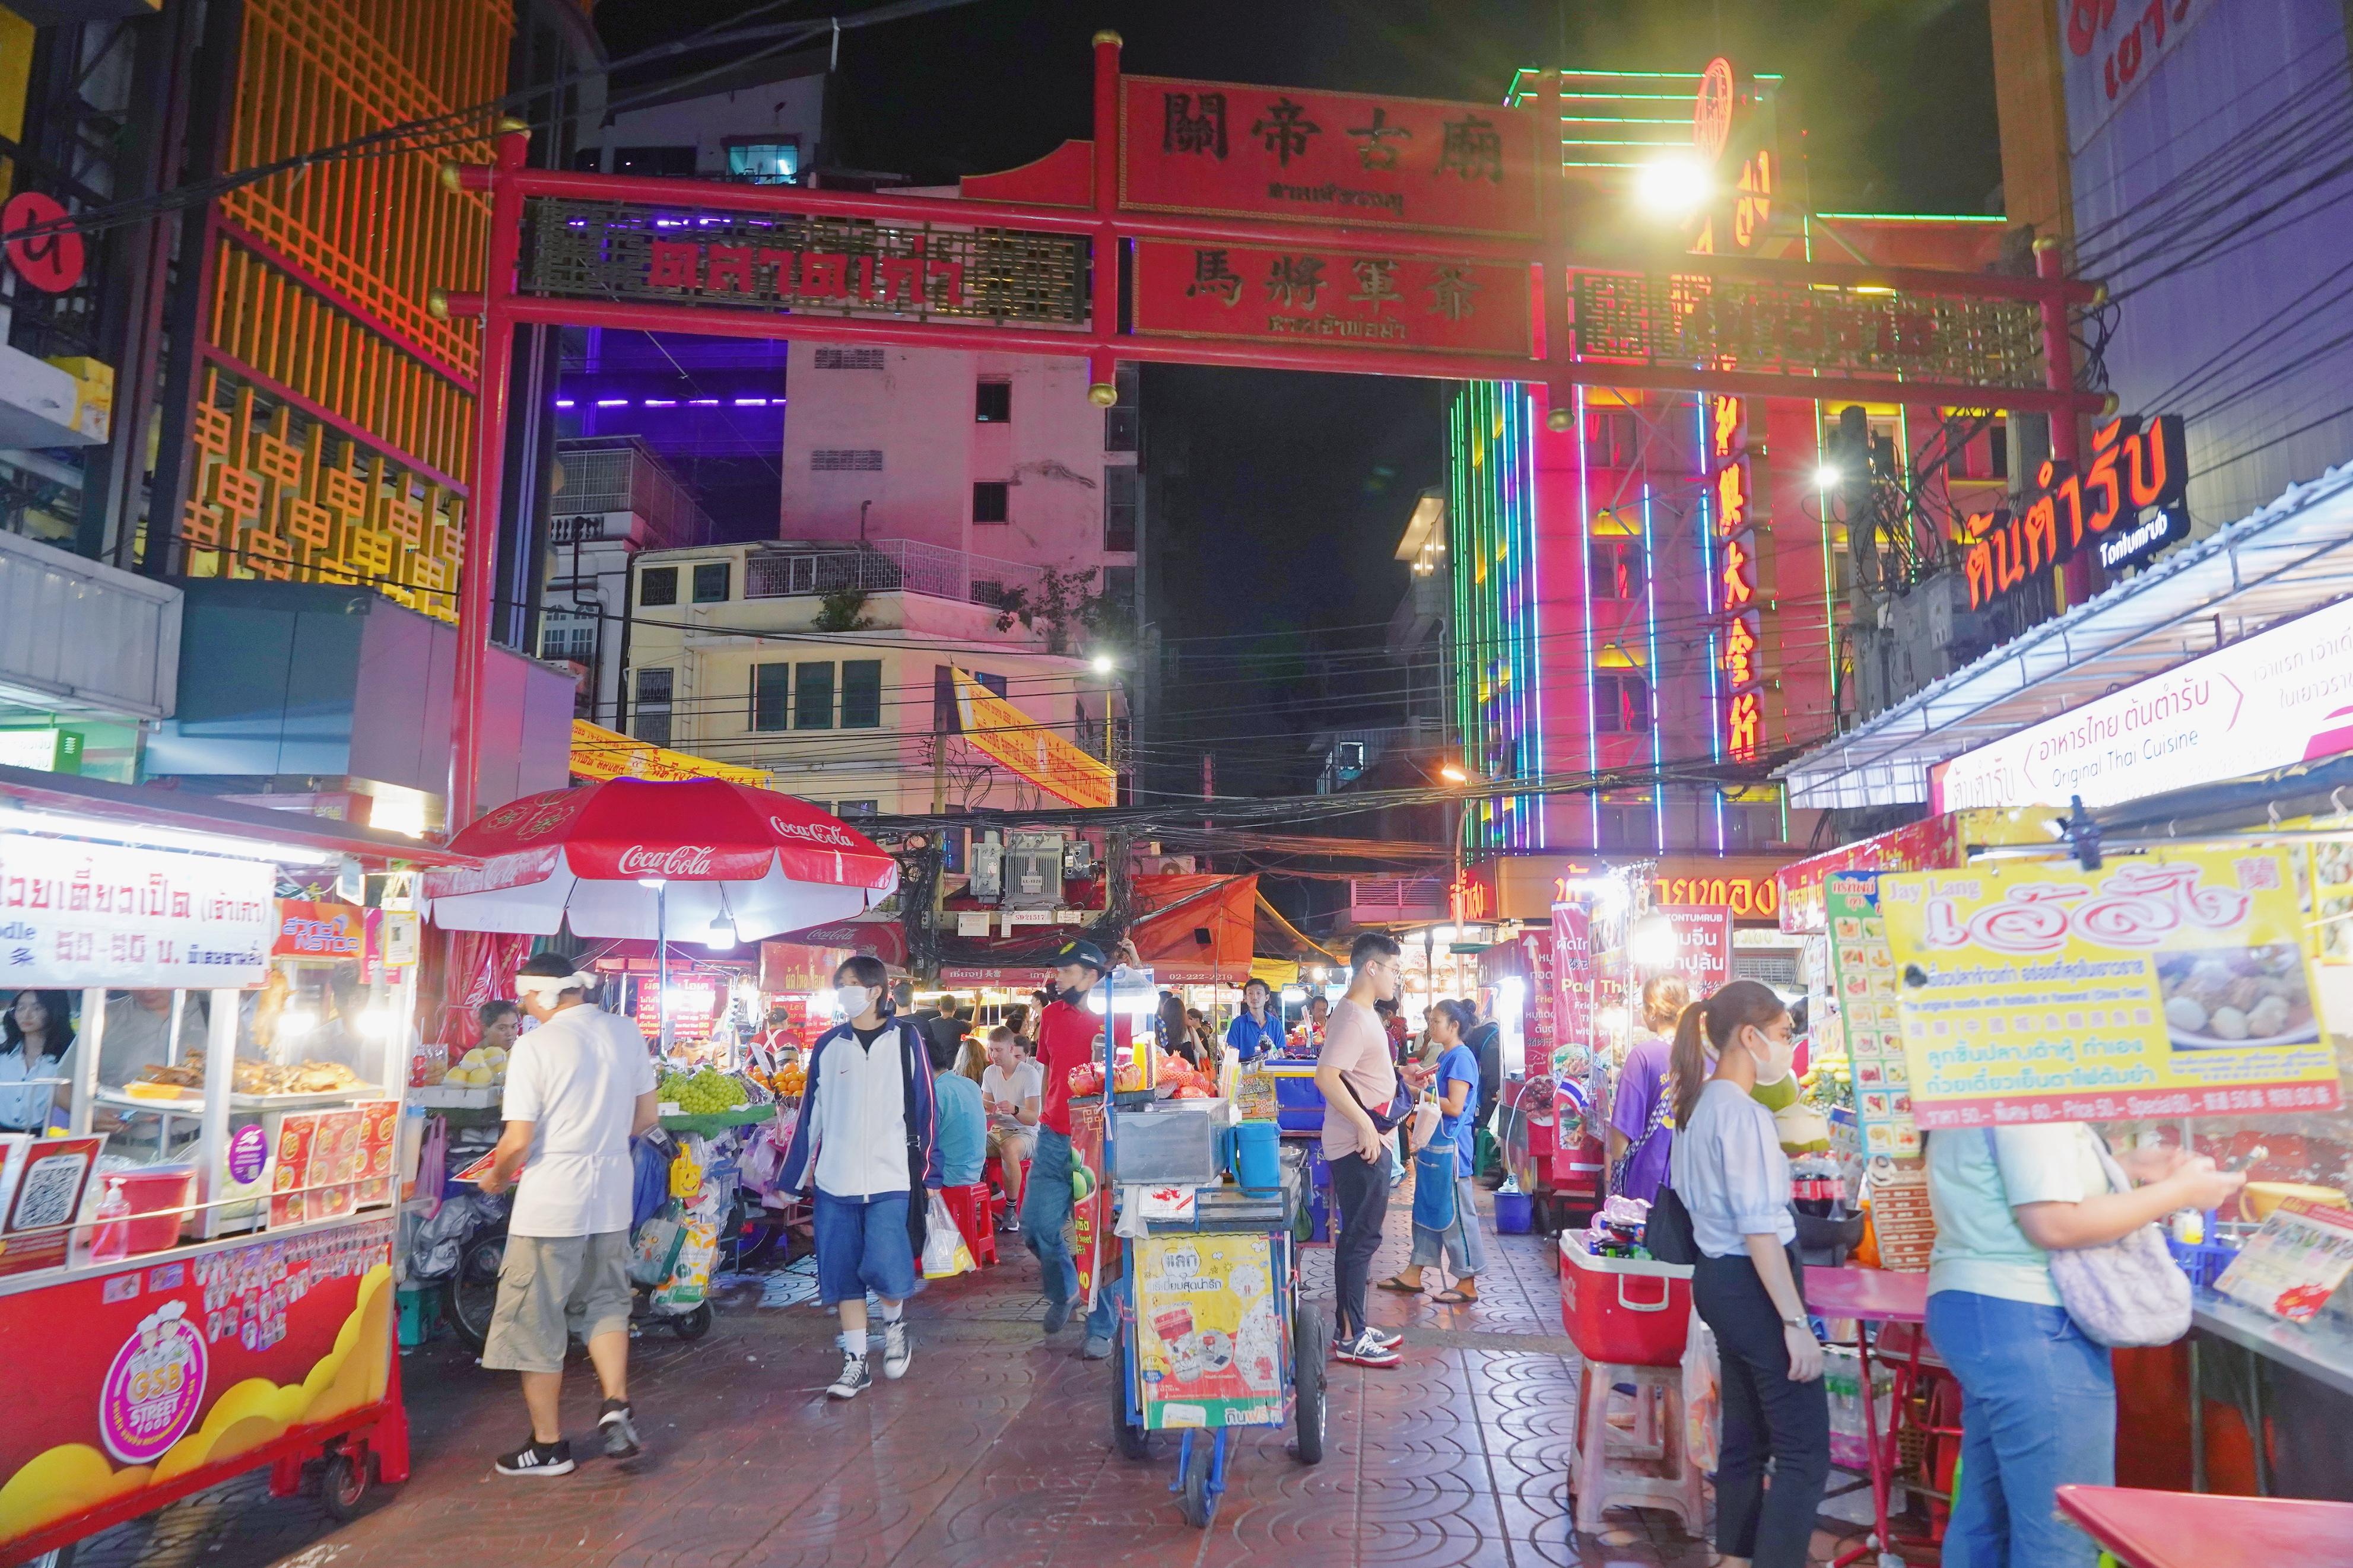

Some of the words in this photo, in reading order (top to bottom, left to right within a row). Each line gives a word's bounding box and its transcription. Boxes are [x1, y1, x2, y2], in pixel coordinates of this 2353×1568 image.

[1163, 91, 1504, 185] 關帝古廟
[647, 235, 963, 306] ตลาดเก่า
[1186, 248, 1484, 322] 馬將軍爺
[1965, 416, 2167, 611] ต้นตำรับ
[2100, 509, 2168, 570] Tontumrub
[2040, 715, 2119, 762] อาหารไทย
[2126, 676, 2211, 731] ต้นตำรับ
[2052, 759, 2103, 789] Original
[2107, 750, 2138, 770] Thai
[2142, 729, 2199, 761] Cuisine
[769, 815, 855, 848] Coca-Cola
[618, 844, 716, 876] Coca-Cola
[1888, 880, 1923, 904] Jay
[1928, 878, 1983, 901] Lang
[806, 927, 860, 941] Coca-Cola
[1535, 994, 1553, 1004] Frie
[134, 1363, 180, 1401] GSB
[129, 1397, 179, 1428] STREET
